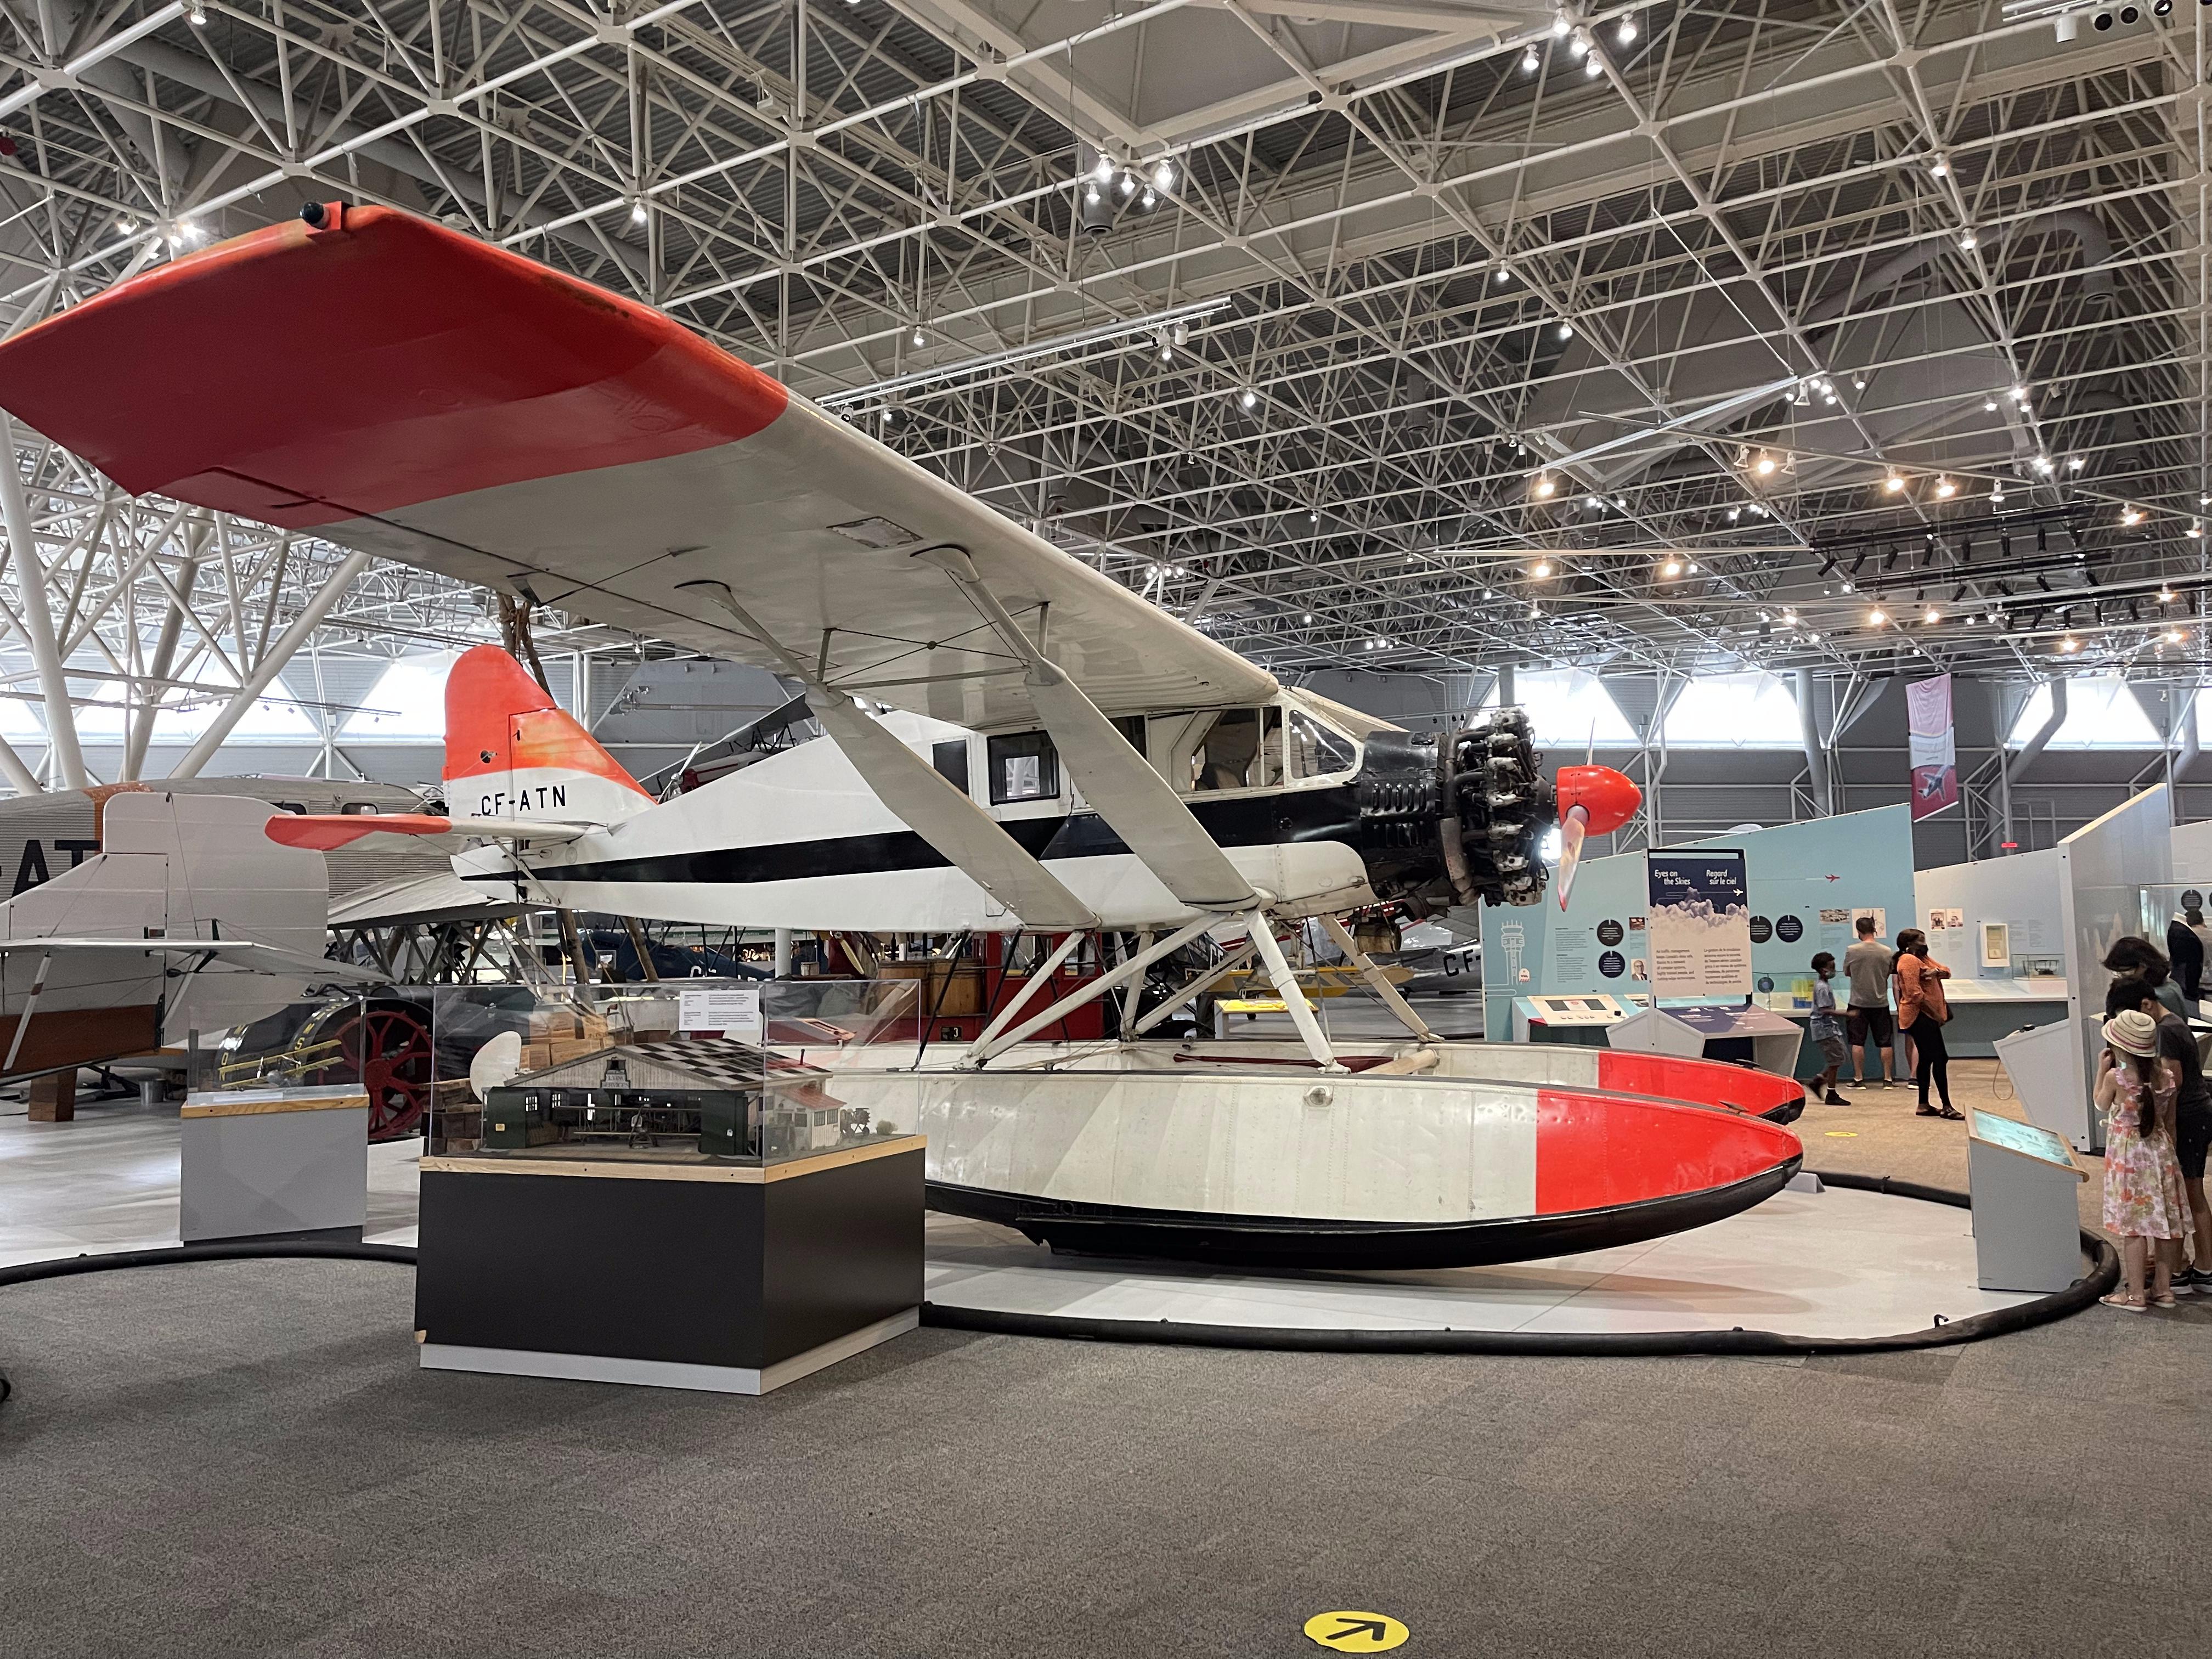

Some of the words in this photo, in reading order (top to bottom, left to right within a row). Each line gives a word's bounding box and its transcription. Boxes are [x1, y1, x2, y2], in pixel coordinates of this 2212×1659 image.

[482, 785, 566, 816] CF-ATN
[1655, 870, 1668, 878] Eyes
[1706, 869, 1728, 879] Regard
[1726, 877, 1736, 885] ciel
